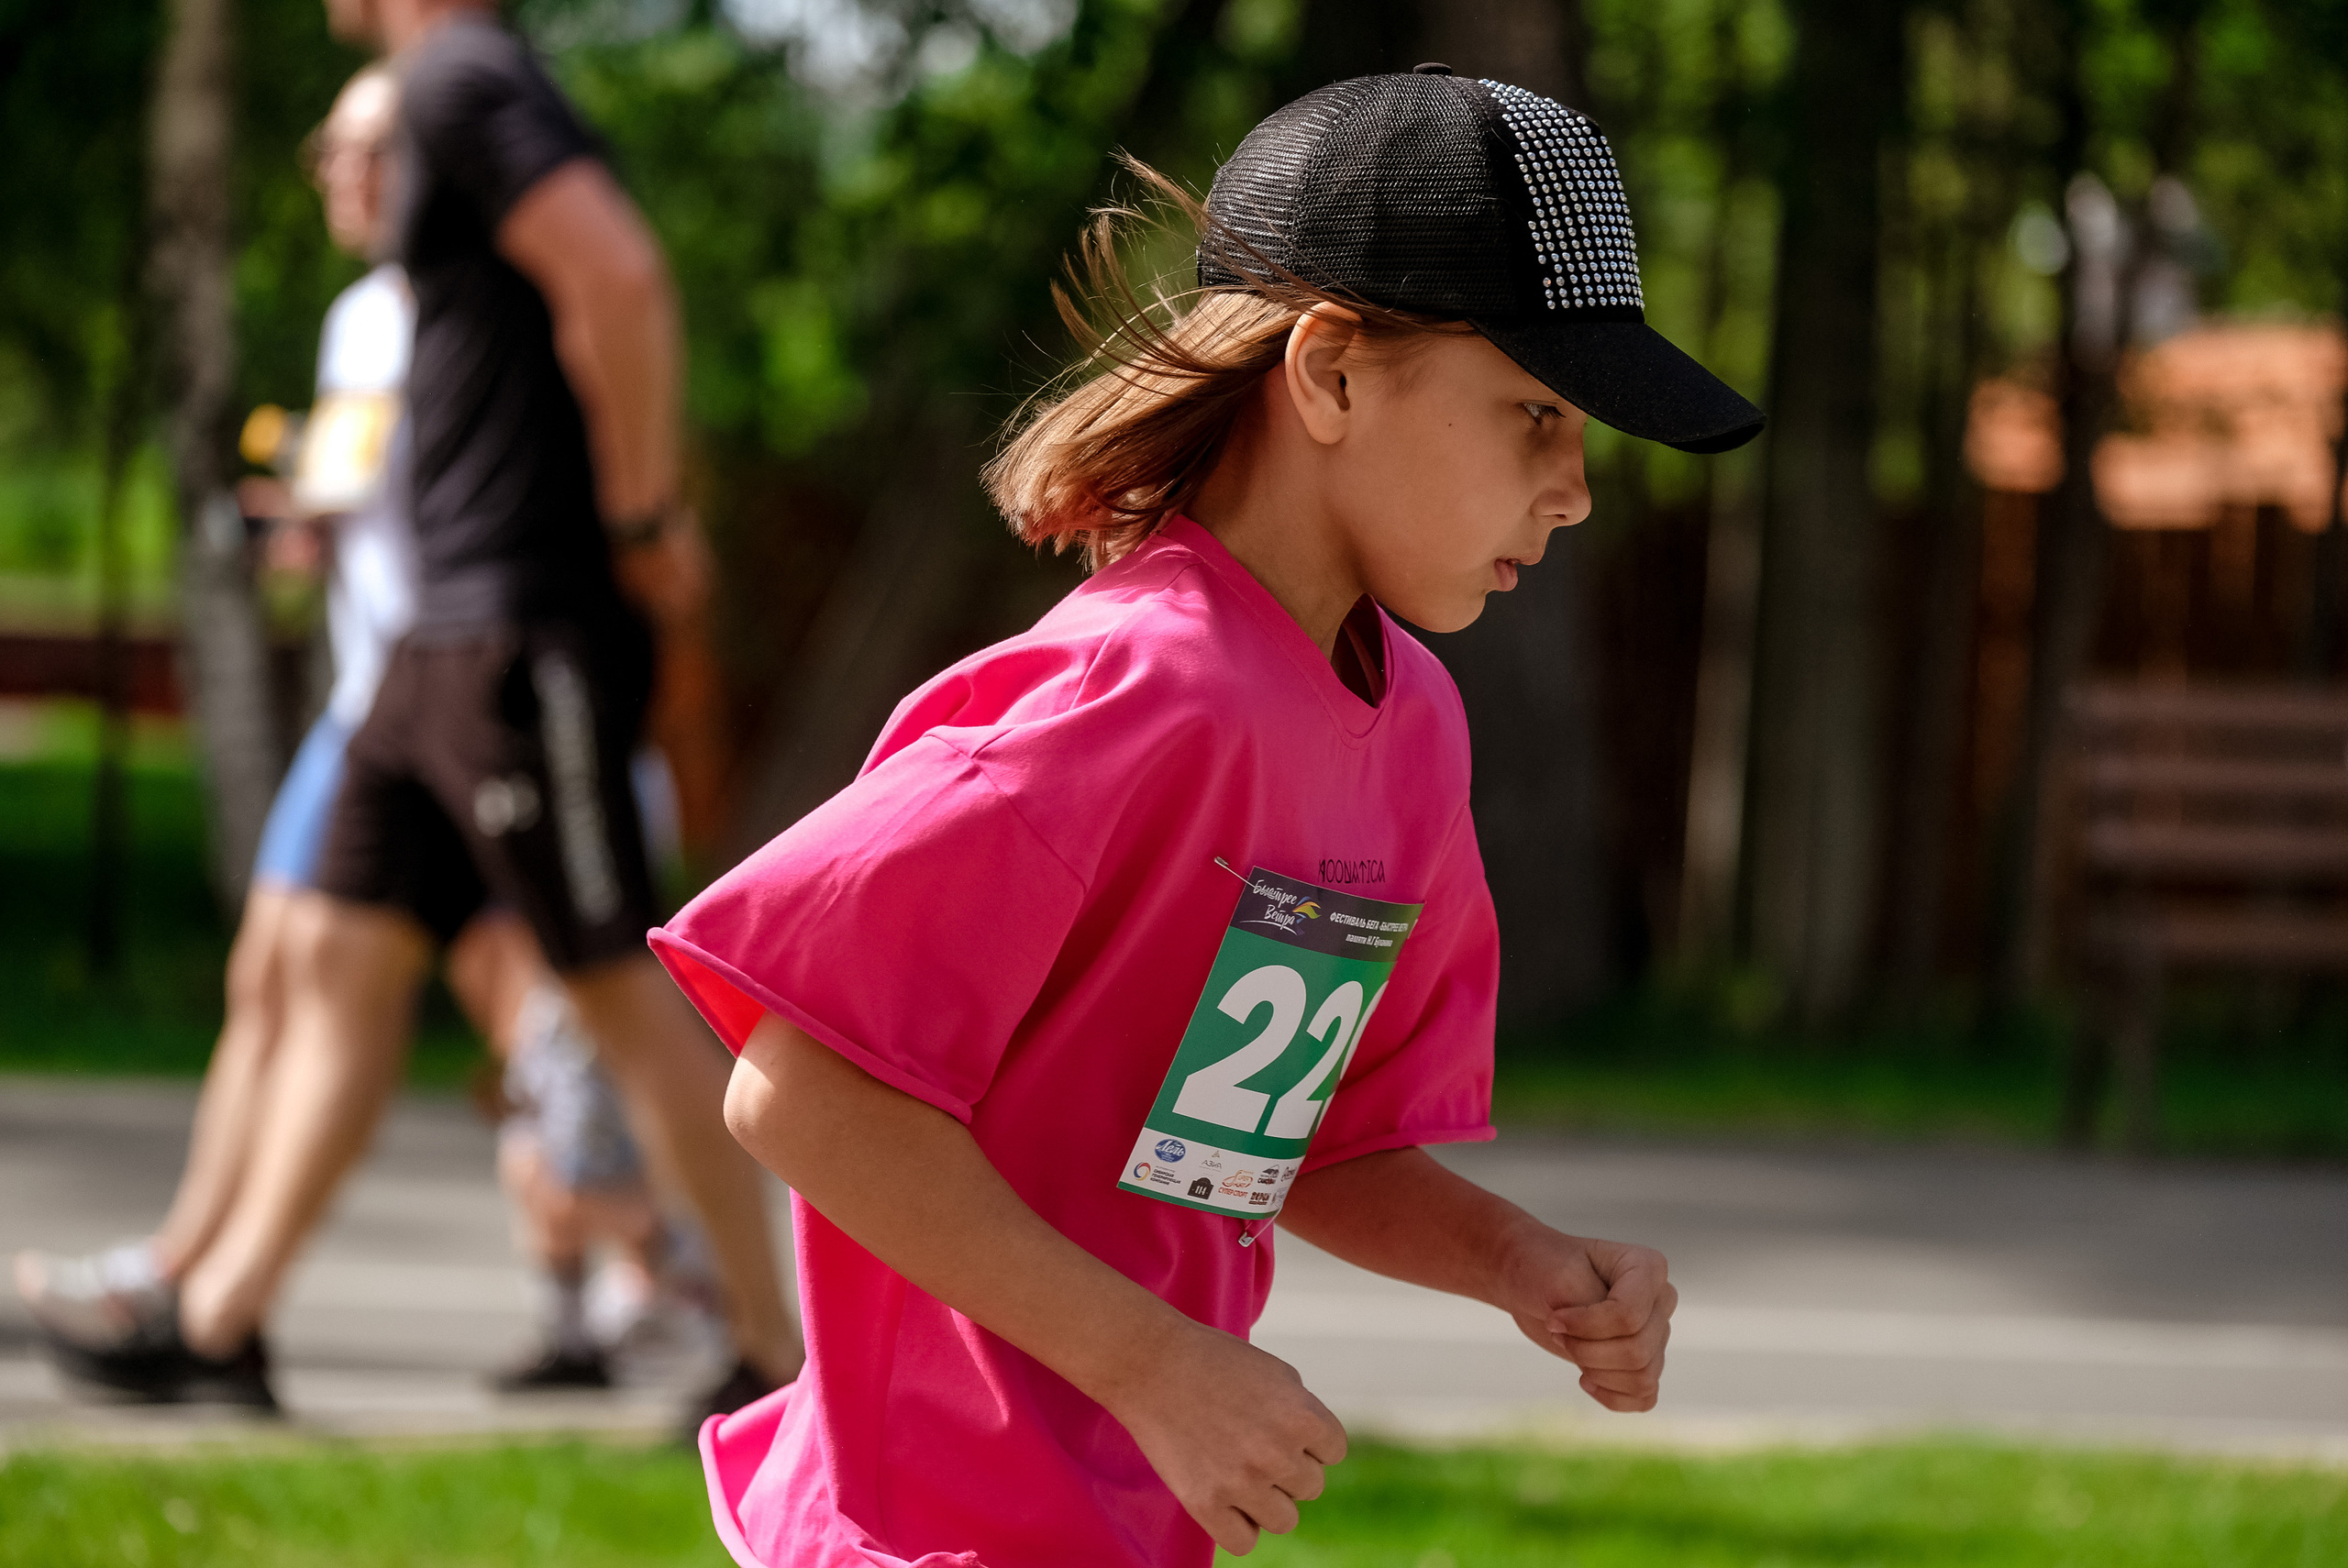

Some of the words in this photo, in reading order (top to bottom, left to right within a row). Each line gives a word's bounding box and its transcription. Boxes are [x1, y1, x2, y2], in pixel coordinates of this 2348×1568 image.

[1264, 904, 1295, 930] Ветра
[1330, 911, 1366, 928] ФЕСТИВАЛЬ
[1366, 920, 1379, 930] БЕГА
[1156, 1140, 1184, 1157] Лель
